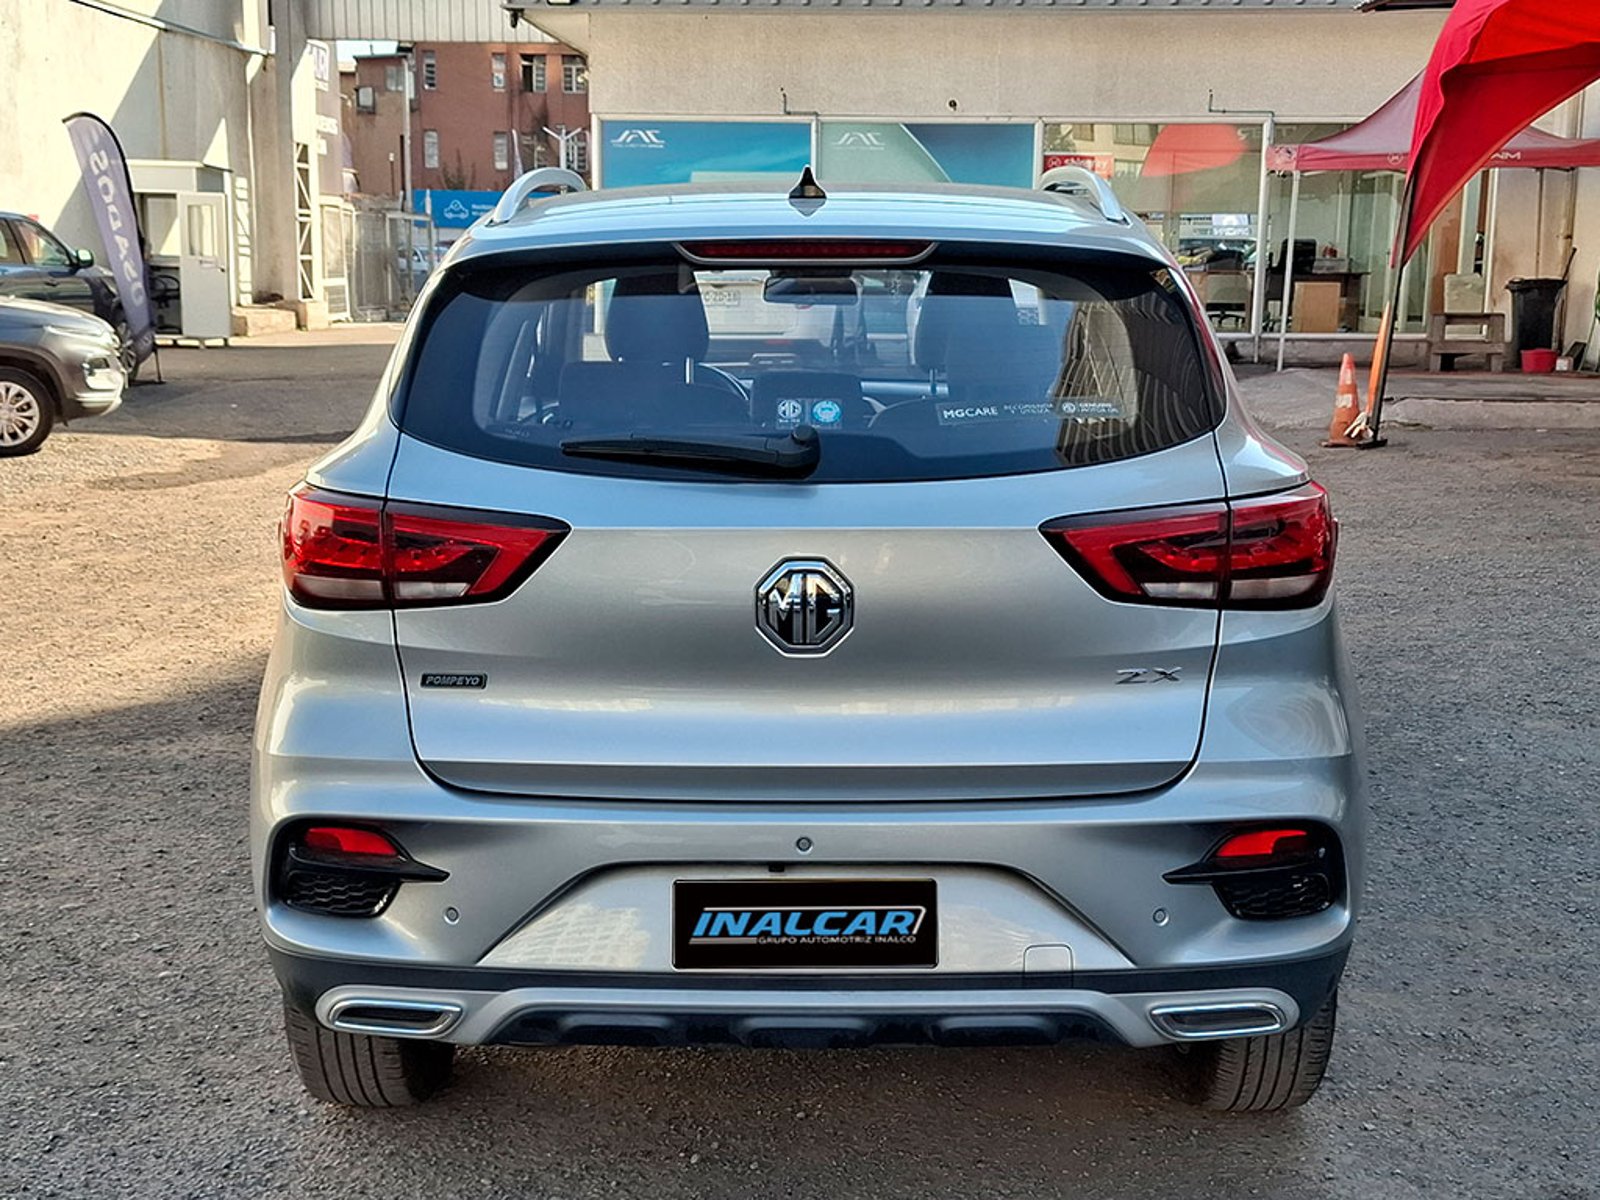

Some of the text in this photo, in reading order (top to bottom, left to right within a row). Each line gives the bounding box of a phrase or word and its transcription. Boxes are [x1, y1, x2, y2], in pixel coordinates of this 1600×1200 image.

[766, 570, 842, 646] MG
[426, 676, 481, 685] POMPEYO
[692, 911, 915, 937] INALCAR
[758, 935, 916, 945] GRUPO AUTOMOTRIZ INALCO
